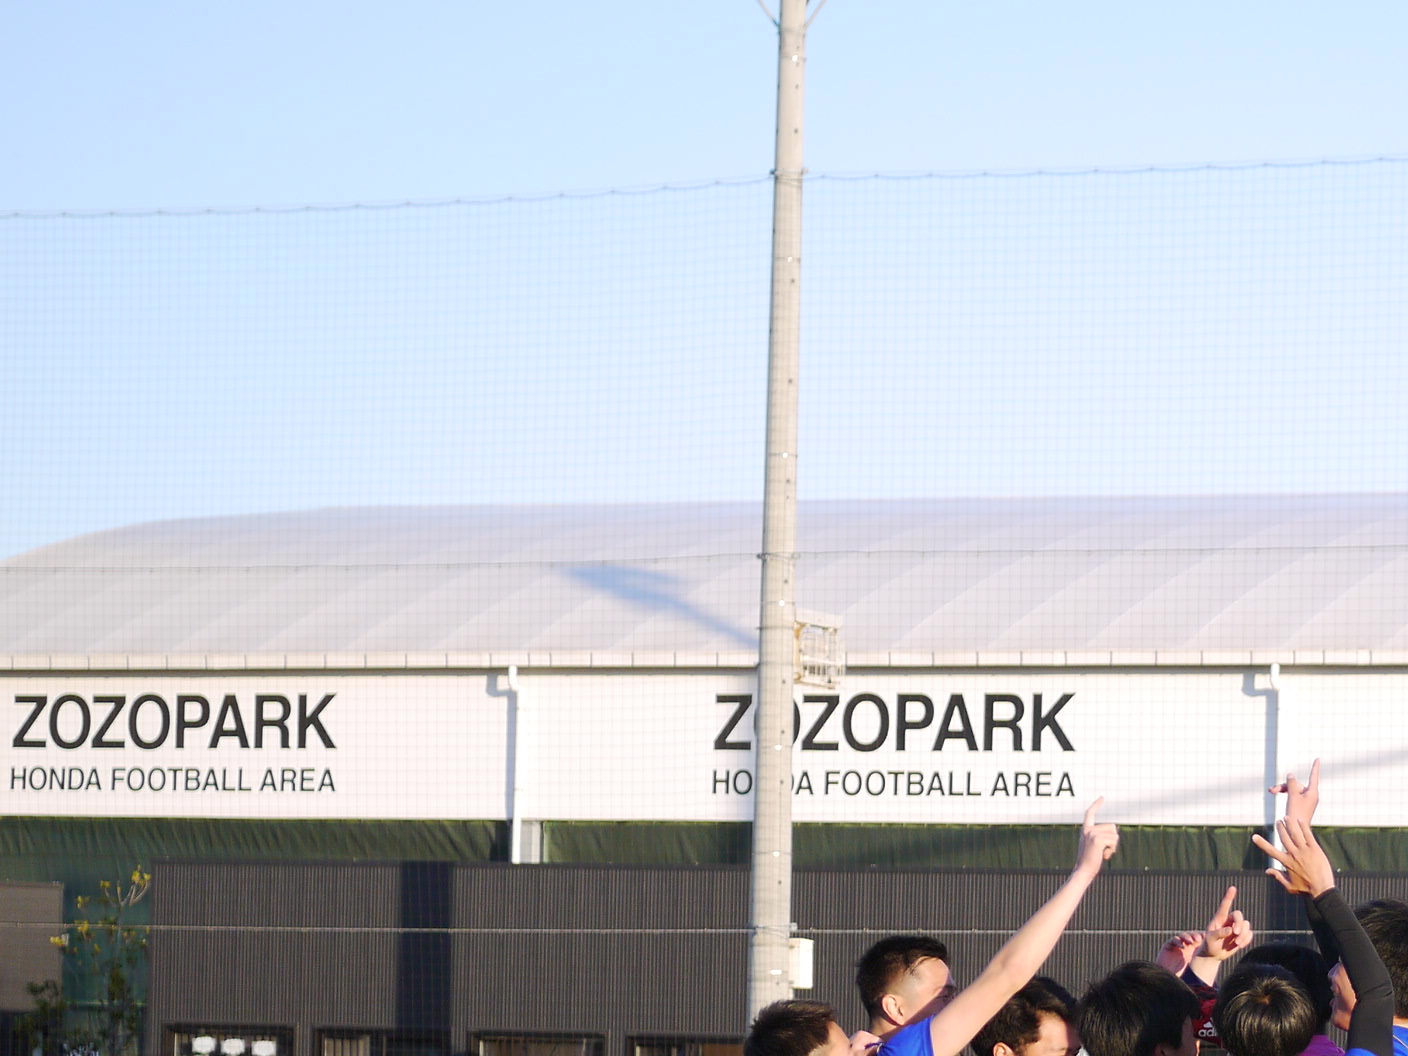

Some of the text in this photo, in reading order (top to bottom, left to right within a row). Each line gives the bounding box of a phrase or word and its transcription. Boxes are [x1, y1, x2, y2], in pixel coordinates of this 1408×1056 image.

[12, 694, 337, 750] ZOZOPARK
[10, 766, 336, 792] HONDA FOOTBALL AREA
[711, 769, 1075, 797] HOA FOOTBALL AREA
